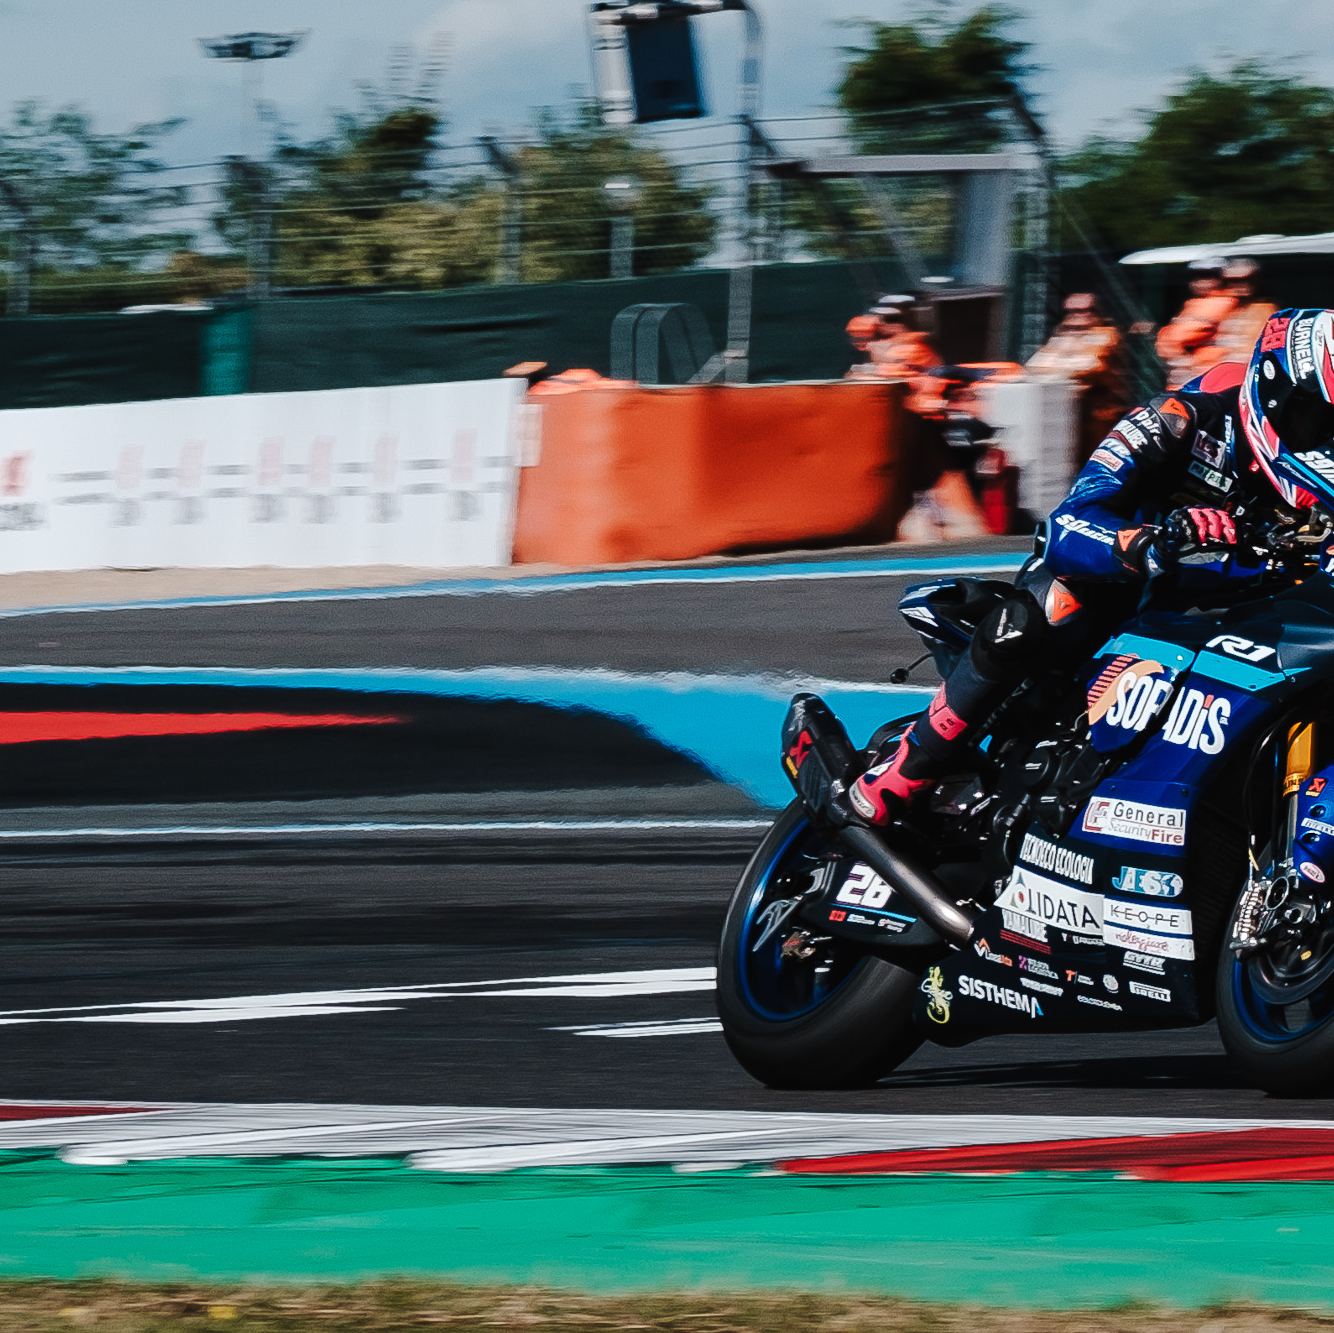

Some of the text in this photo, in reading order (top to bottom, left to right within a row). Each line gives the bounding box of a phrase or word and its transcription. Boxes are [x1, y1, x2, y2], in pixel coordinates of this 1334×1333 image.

[1113, 801, 1185, 827] General
[1110, 904, 1180, 928] KEOPE
[958, 974, 1044, 1019] SISTHEMA
